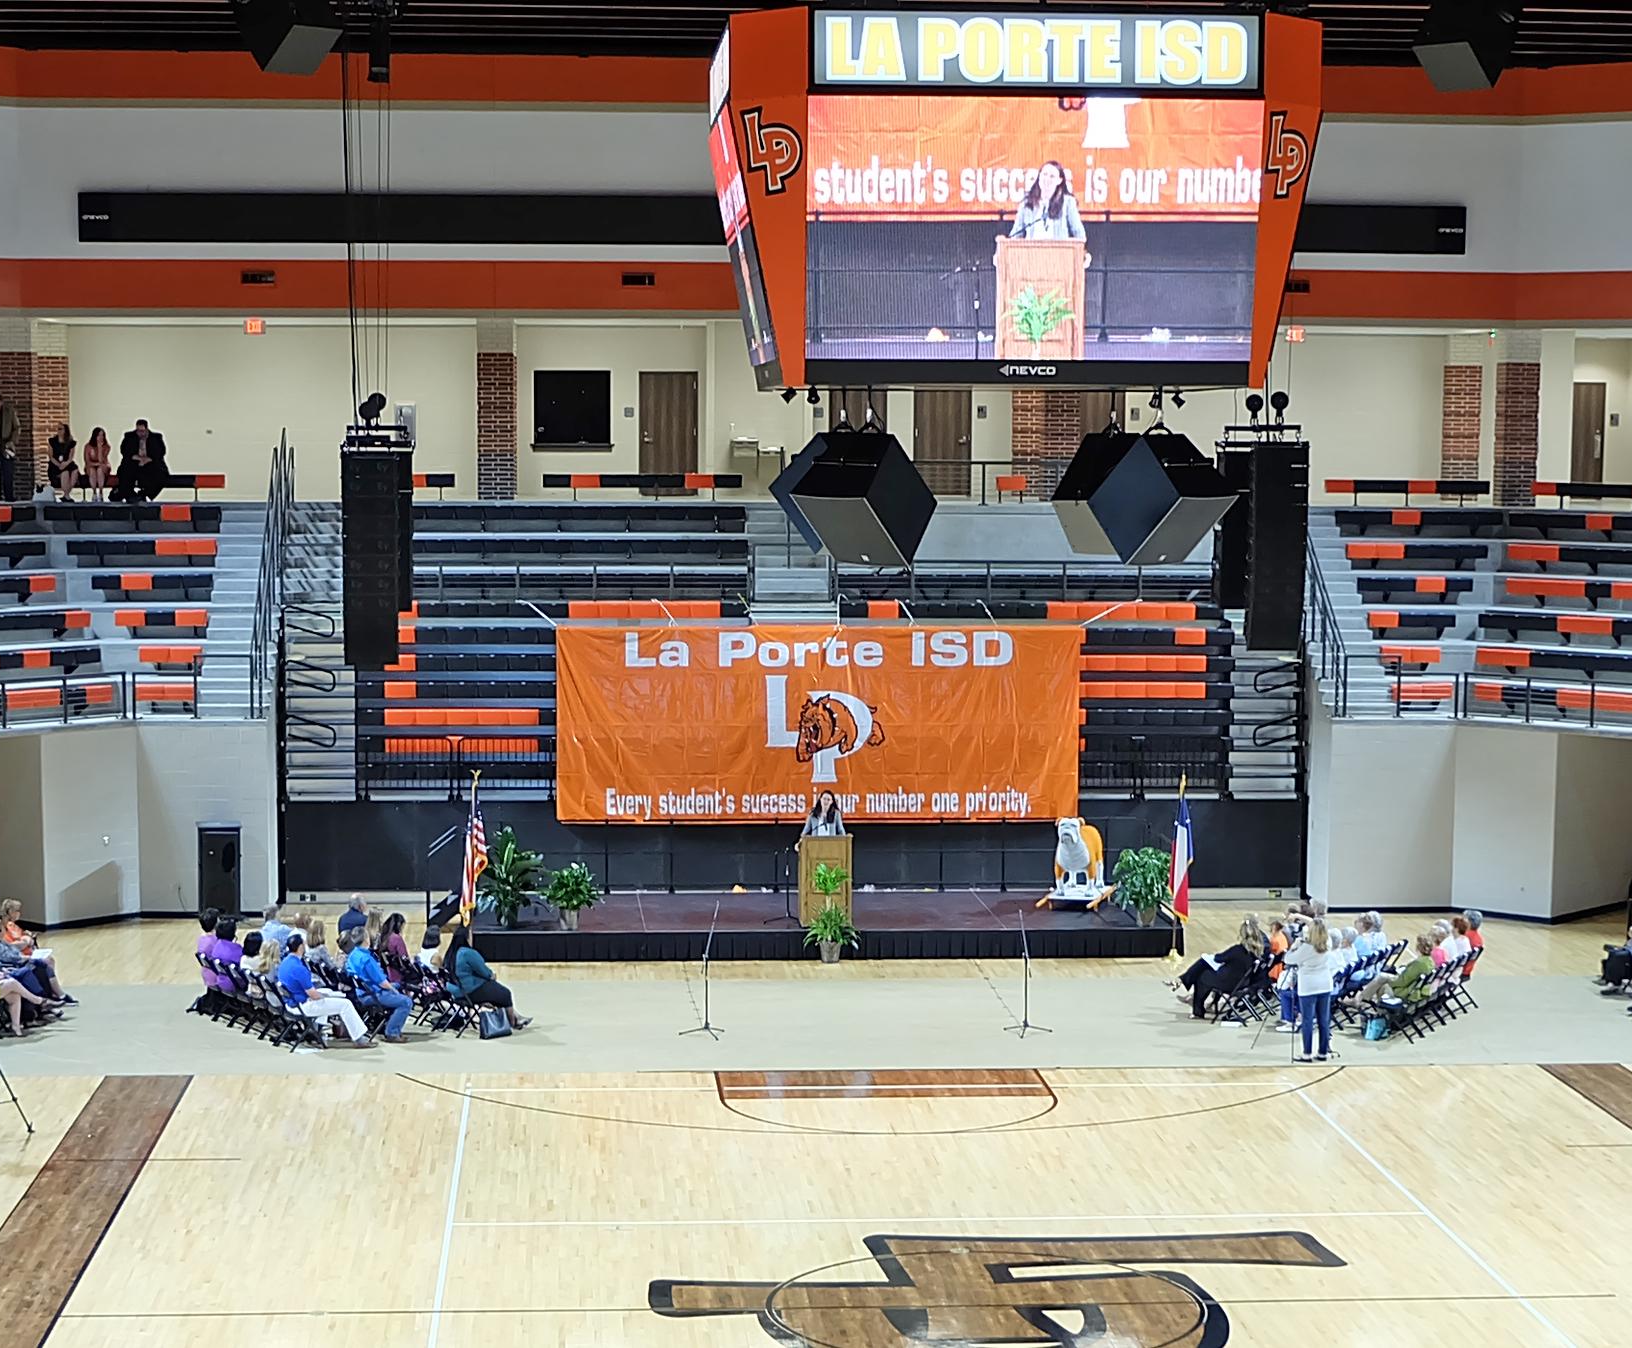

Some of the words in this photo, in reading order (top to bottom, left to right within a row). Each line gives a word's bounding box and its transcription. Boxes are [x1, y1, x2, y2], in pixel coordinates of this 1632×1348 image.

[825, 16, 907, 81] LA
[918, 17, 1122, 84] PORTE
[1135, 20, 1248, 85] ISD
[814, 155, 949, 203] student's
[1085, 155, 1109, 203] is
[1119, 167, 1167, 203] our
[624, 631, 689, 668] La
[717, 631, 883, 668] Porte
[911, 631, 1014, 667] ISD
[606, 787, 652, 821] Every
[658, 787, 735, 815] student's
[741, 793, 806, 815] success
[866, 786, 925, 813] number
[931, 792, 959, 813] one
[966, 785, 1032, 818] priority.
